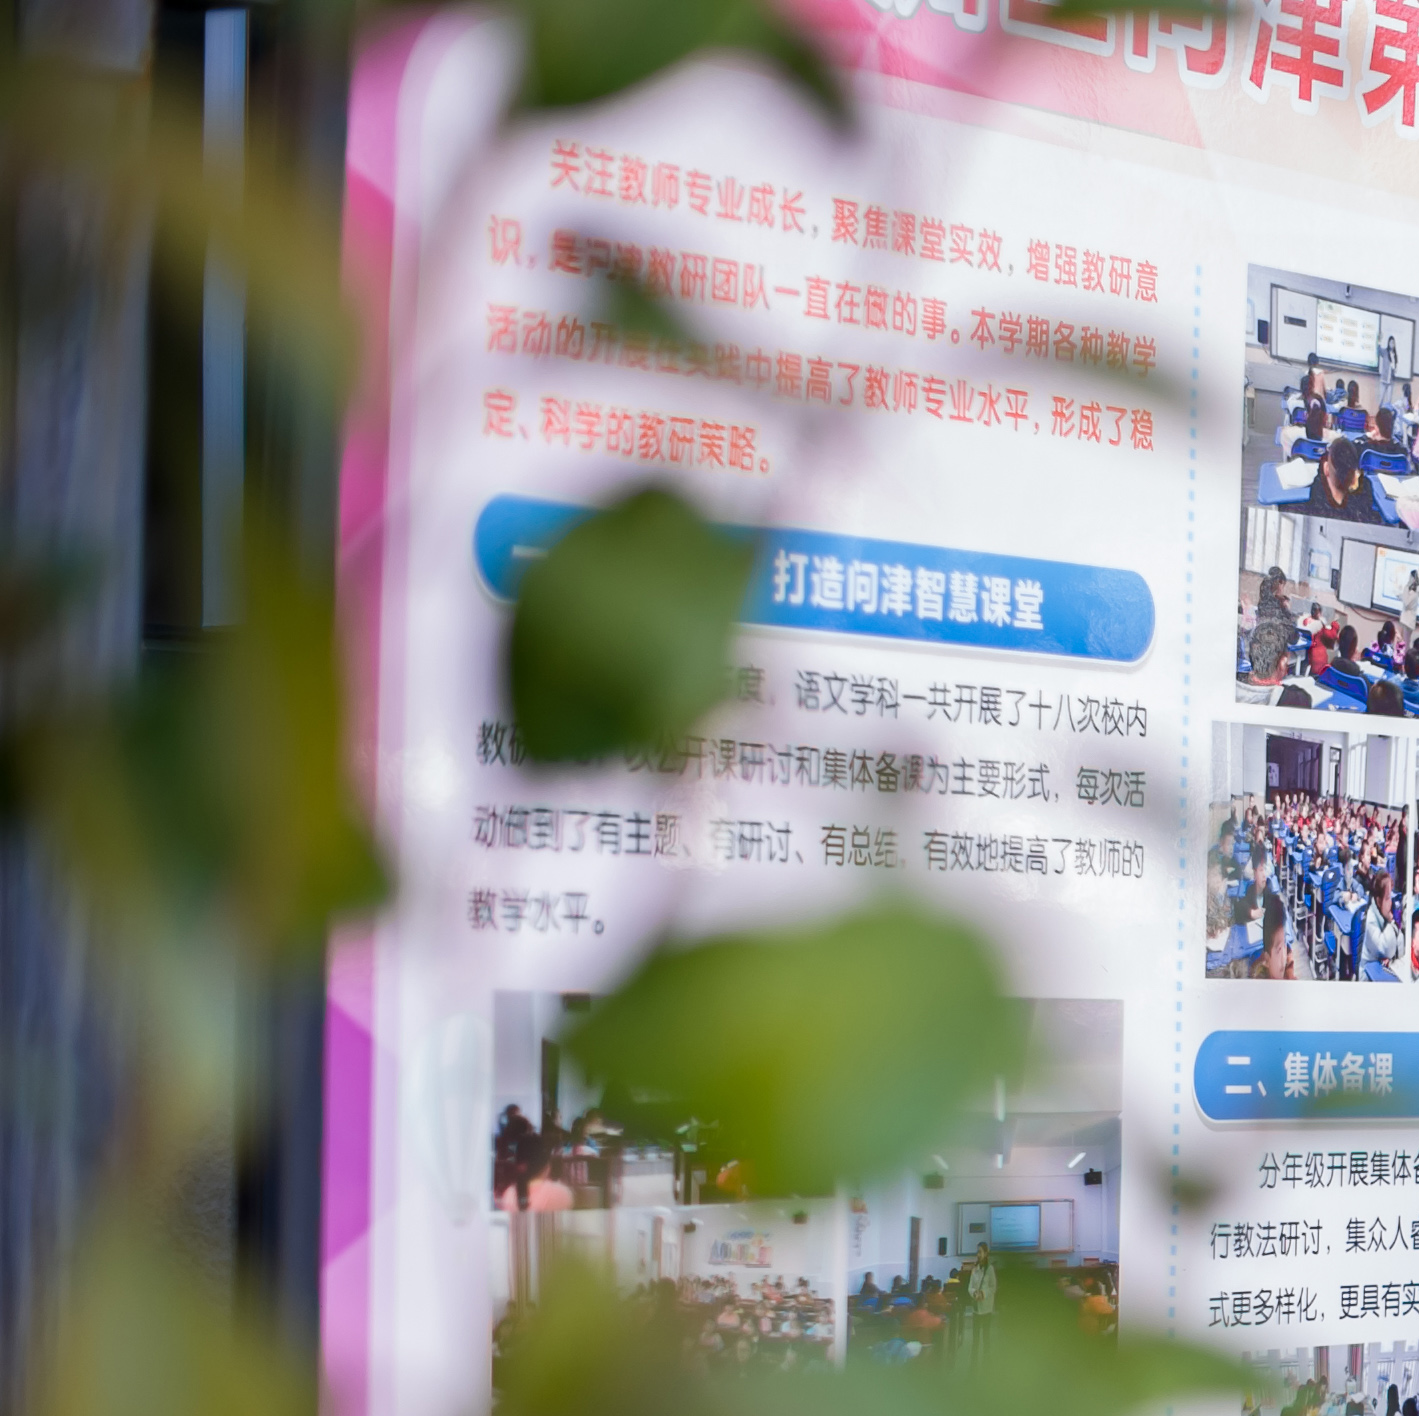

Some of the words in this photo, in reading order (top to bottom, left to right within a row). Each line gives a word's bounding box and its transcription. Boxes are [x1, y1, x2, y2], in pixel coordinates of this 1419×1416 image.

[483, 389, 769, 473] 定、科学的教研策略。
[773, 548, 1045, 631] 打造问津智慧课堂
[730, 663, 1148, 738] 度，语文学科一共开展了十八次校内
[468, 888, 605, 935] 教学水平。
[1225, 1051, 1394, 1098] 二、集体备课
